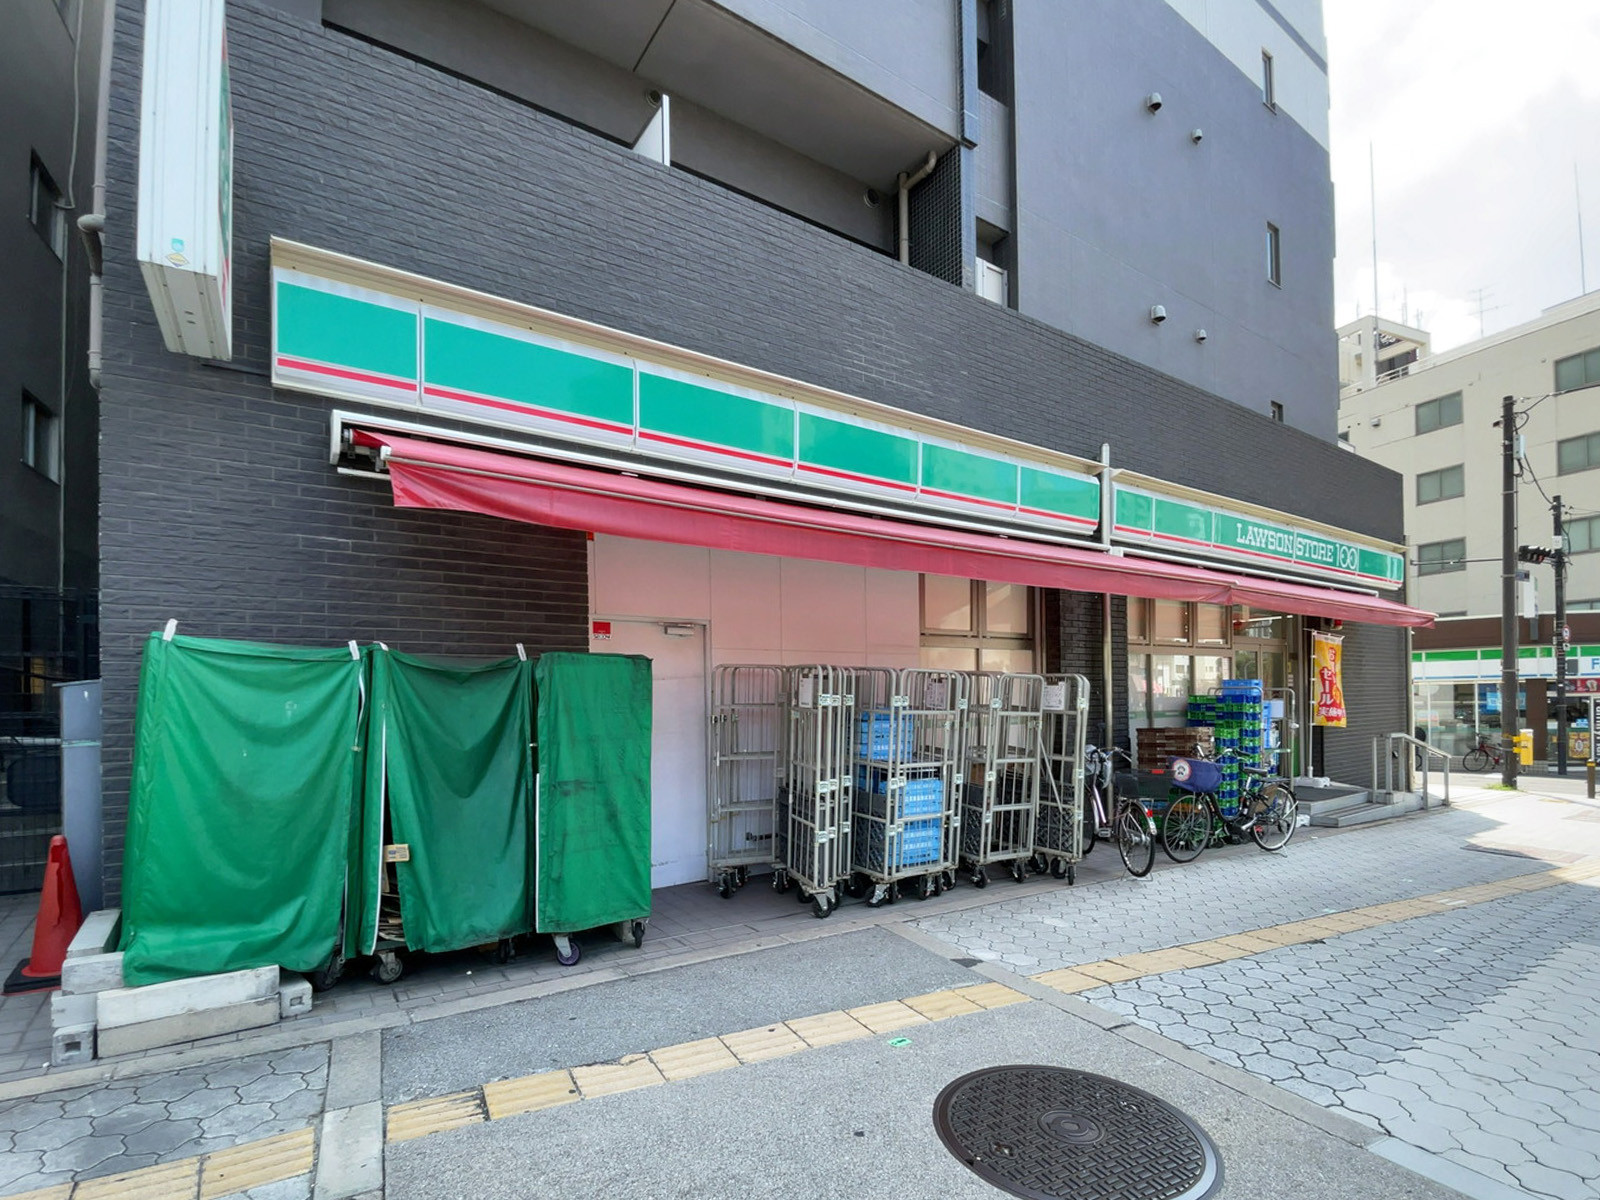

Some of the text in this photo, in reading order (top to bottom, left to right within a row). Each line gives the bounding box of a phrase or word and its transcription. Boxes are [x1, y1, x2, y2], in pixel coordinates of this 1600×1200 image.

[1236, 523, 1358, 569] LAWSON STORE 100
